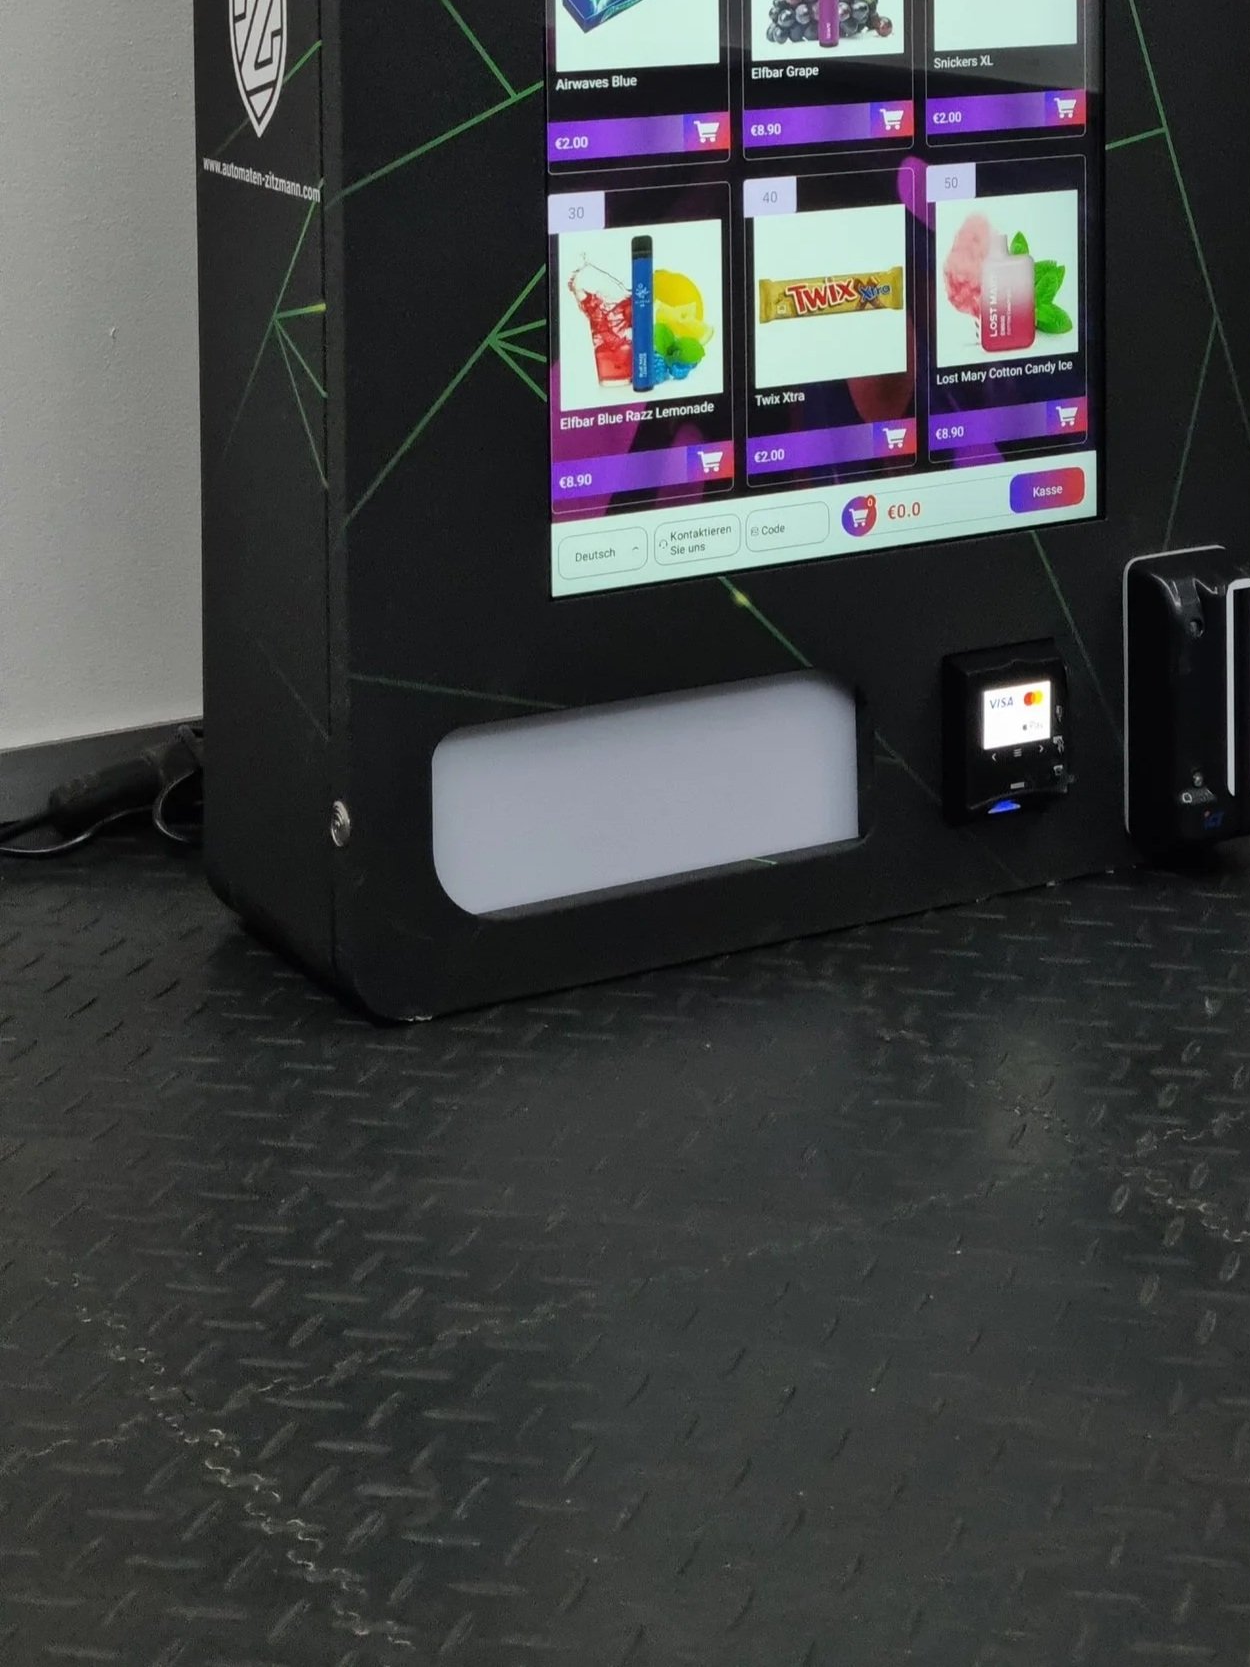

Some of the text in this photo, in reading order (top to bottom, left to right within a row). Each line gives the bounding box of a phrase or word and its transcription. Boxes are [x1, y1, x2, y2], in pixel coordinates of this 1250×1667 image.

[933, 55, 994, 69] Snickers XL
[751, 64, 819, 80] Elfbar Grape
[556, 75, 638, 91] Airwaves Blue
[932, 111, 962, 124] €2.00
[751, 123, 782, 137] €8.90
[555, 136, 589, 150] €2.00
[202, 156, 321, 204] www.automaten-zitzmann.com
[944, 177, 958, 189] 50
[762, 191, 779, 204] 40
[568, 206, 585, 220] 30
[936, 360, 1073, 386] Lost Mary Cotton Candy Ice
[755, 391, 806, 407] Twix Xtra
[559, 401, 715, 431] Elfbar Blue Razz Lemonade
[935, 426, 965, 441] €8.90
[754, 448, 785, 463] €2.00
[559, 473, 593, 489] €8.90
[1032, 484, 1063, 499] Kasse
[887, 501, 921, 520] €0.0
[670, 524, 732, 542] Kontaktieren
[761, 523, 786, 536] Code
[575, 547, 616, 563] Deutsch
[670, 543, 706, 556] Sie uns
[989, 696, 1014, 710] VISA
